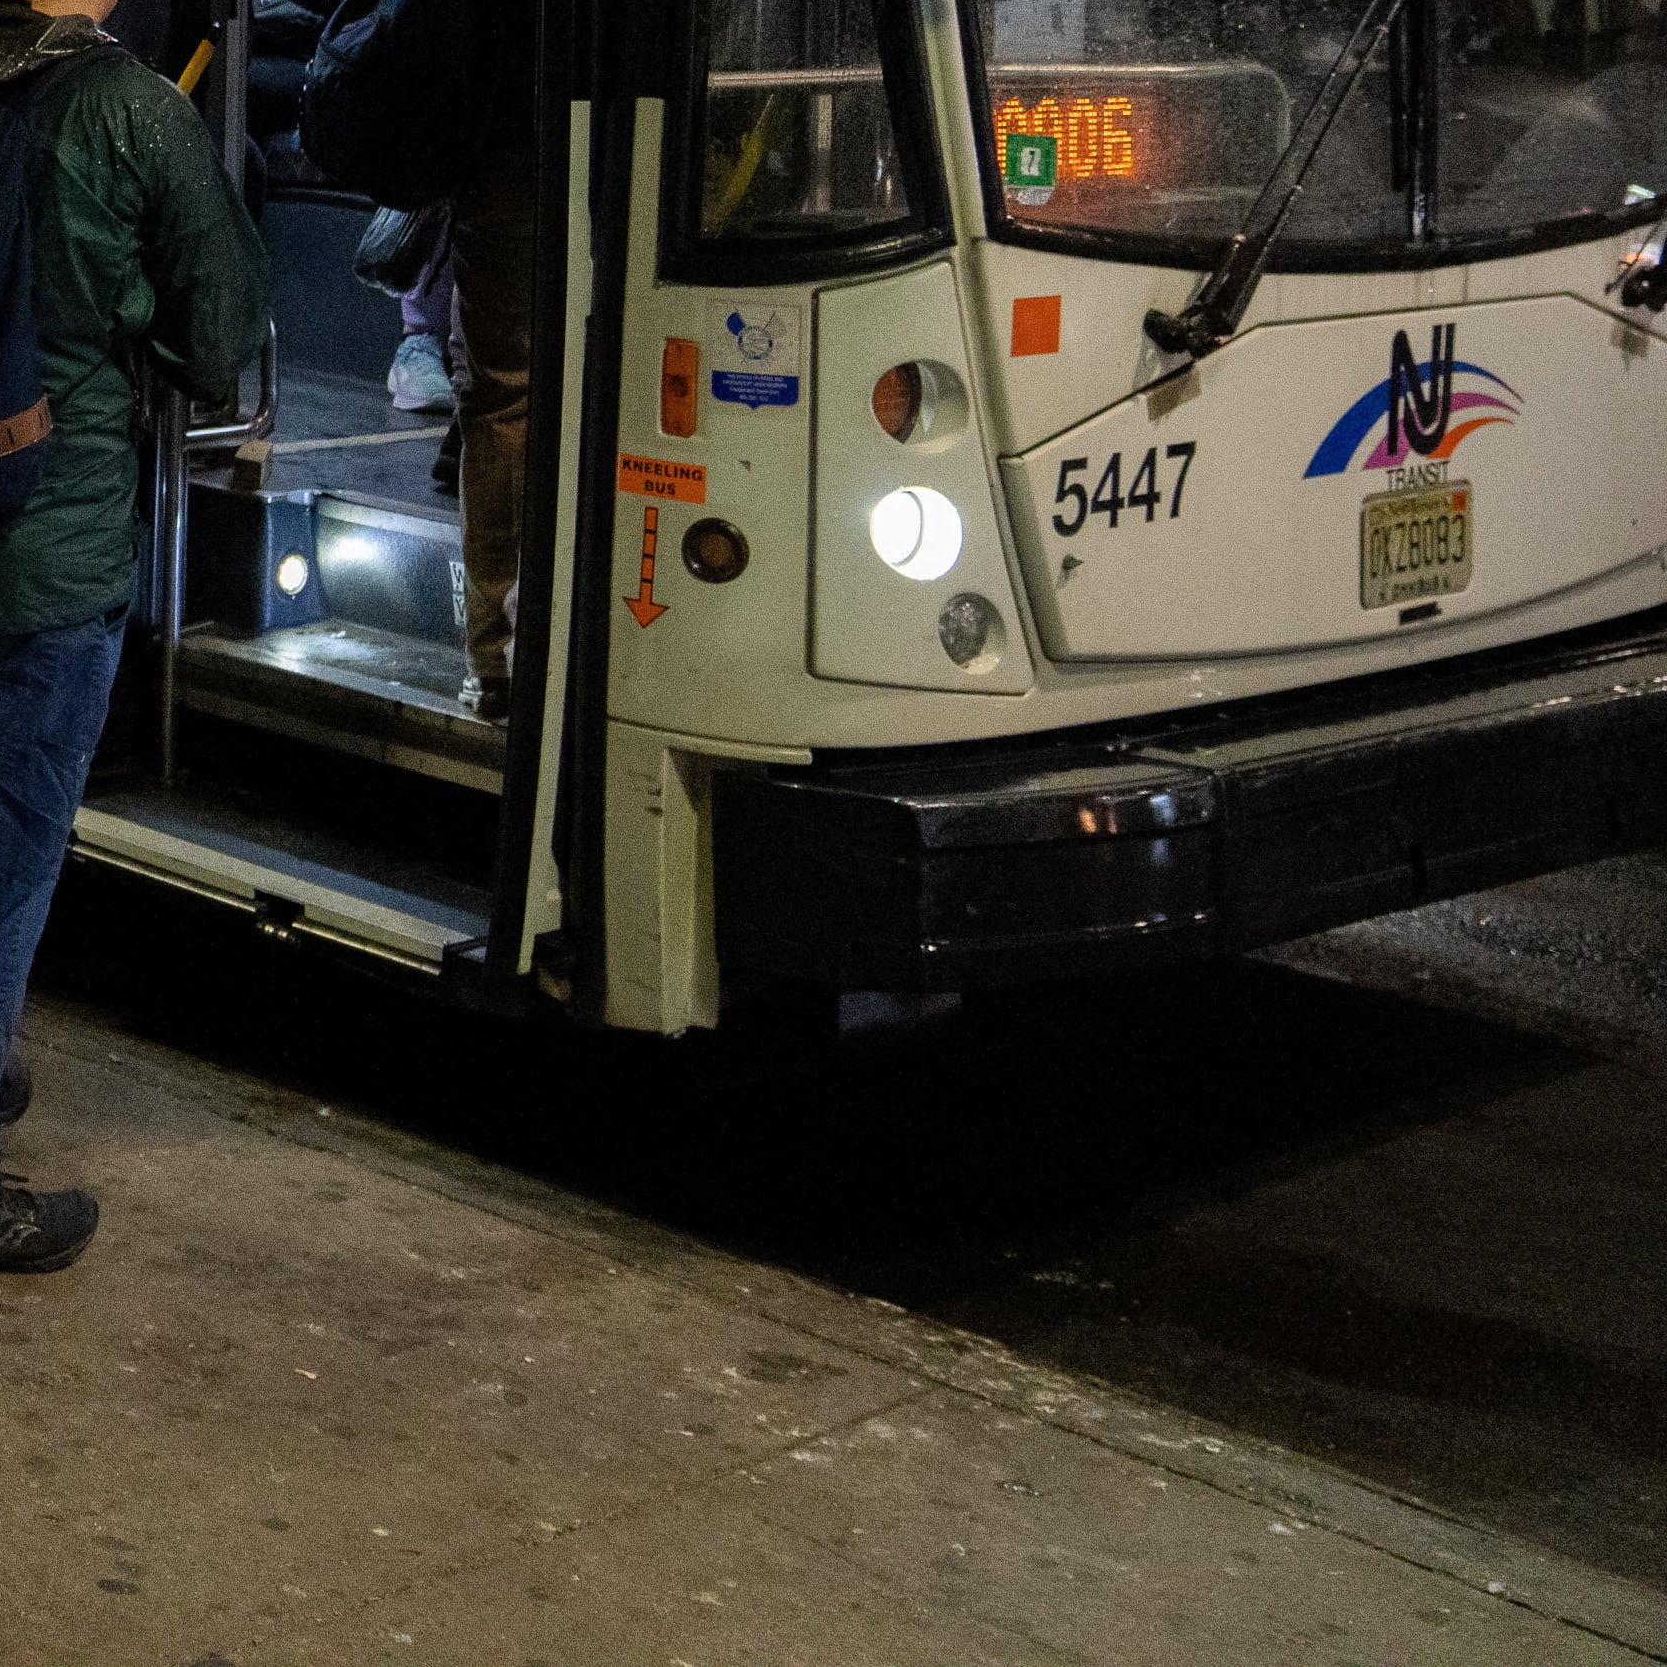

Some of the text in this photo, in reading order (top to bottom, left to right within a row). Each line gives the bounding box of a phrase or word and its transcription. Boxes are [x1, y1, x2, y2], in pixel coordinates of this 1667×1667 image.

[1388, 322, 1457, 456] NJ
[622, 459, 703, 482] KNEELING
[1386, 460, 1450, 492] TRANSIT
[644, 479, 677, 496] BUS
[1052, 440, 1197, 538] 5447
